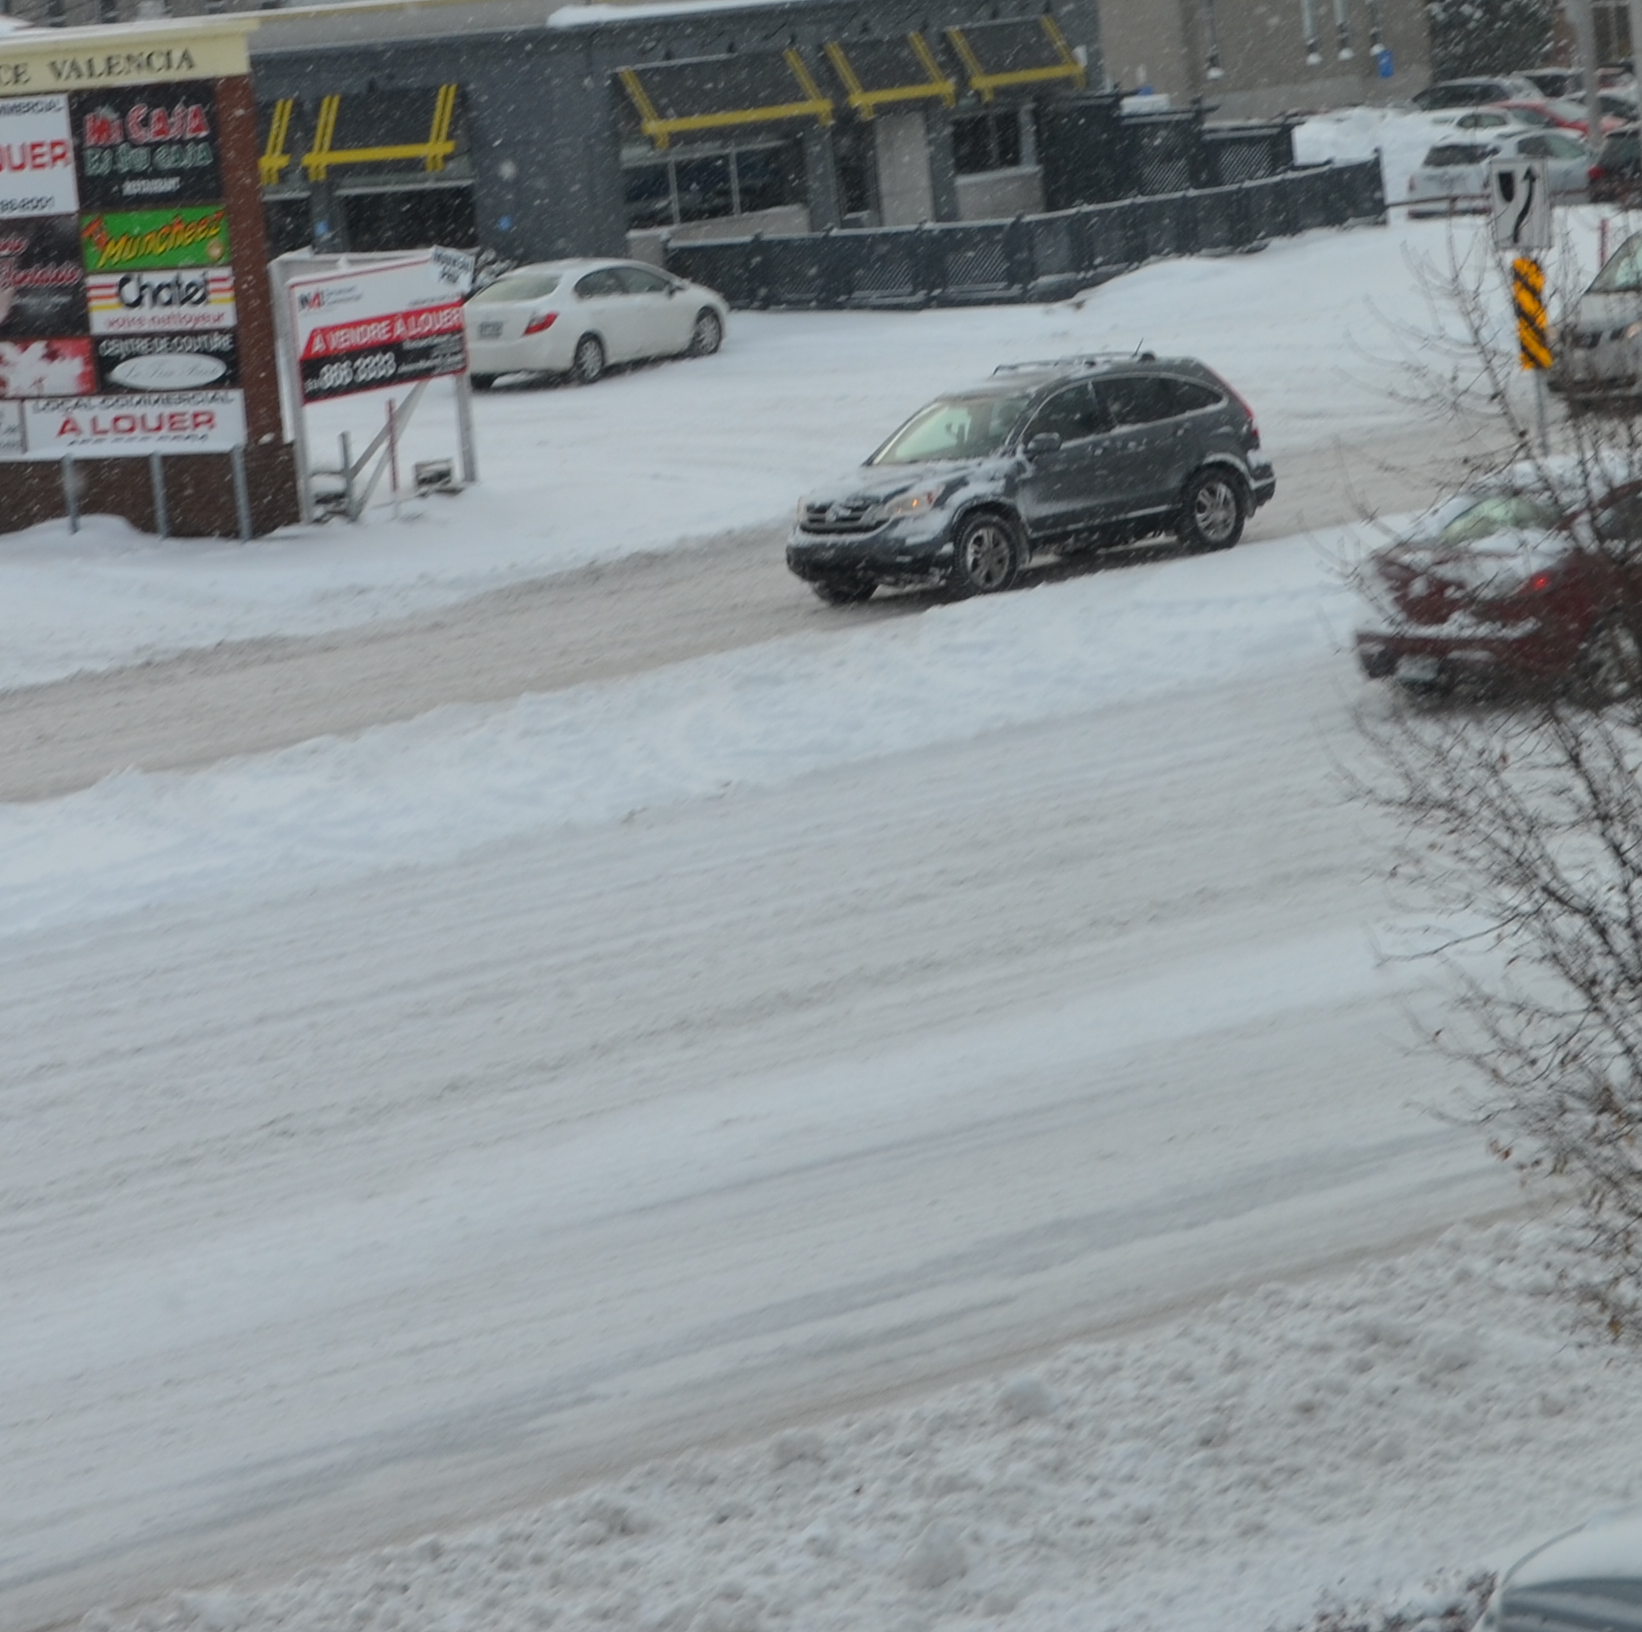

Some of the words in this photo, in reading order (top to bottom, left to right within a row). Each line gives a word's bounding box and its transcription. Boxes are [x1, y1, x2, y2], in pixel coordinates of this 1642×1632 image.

[47, 47, 196, 82] VALENCIA
[117, 272, 208, 309] Chatel
[311, 328, 327, 355] À
[326, 320, 391, 350] VENDRE
[393, 313, 408, 339] À
[407, 306, 464, 335] LOUER
[55, 411, 82, 439] À
[90, 409, 217, 436] LOUER
